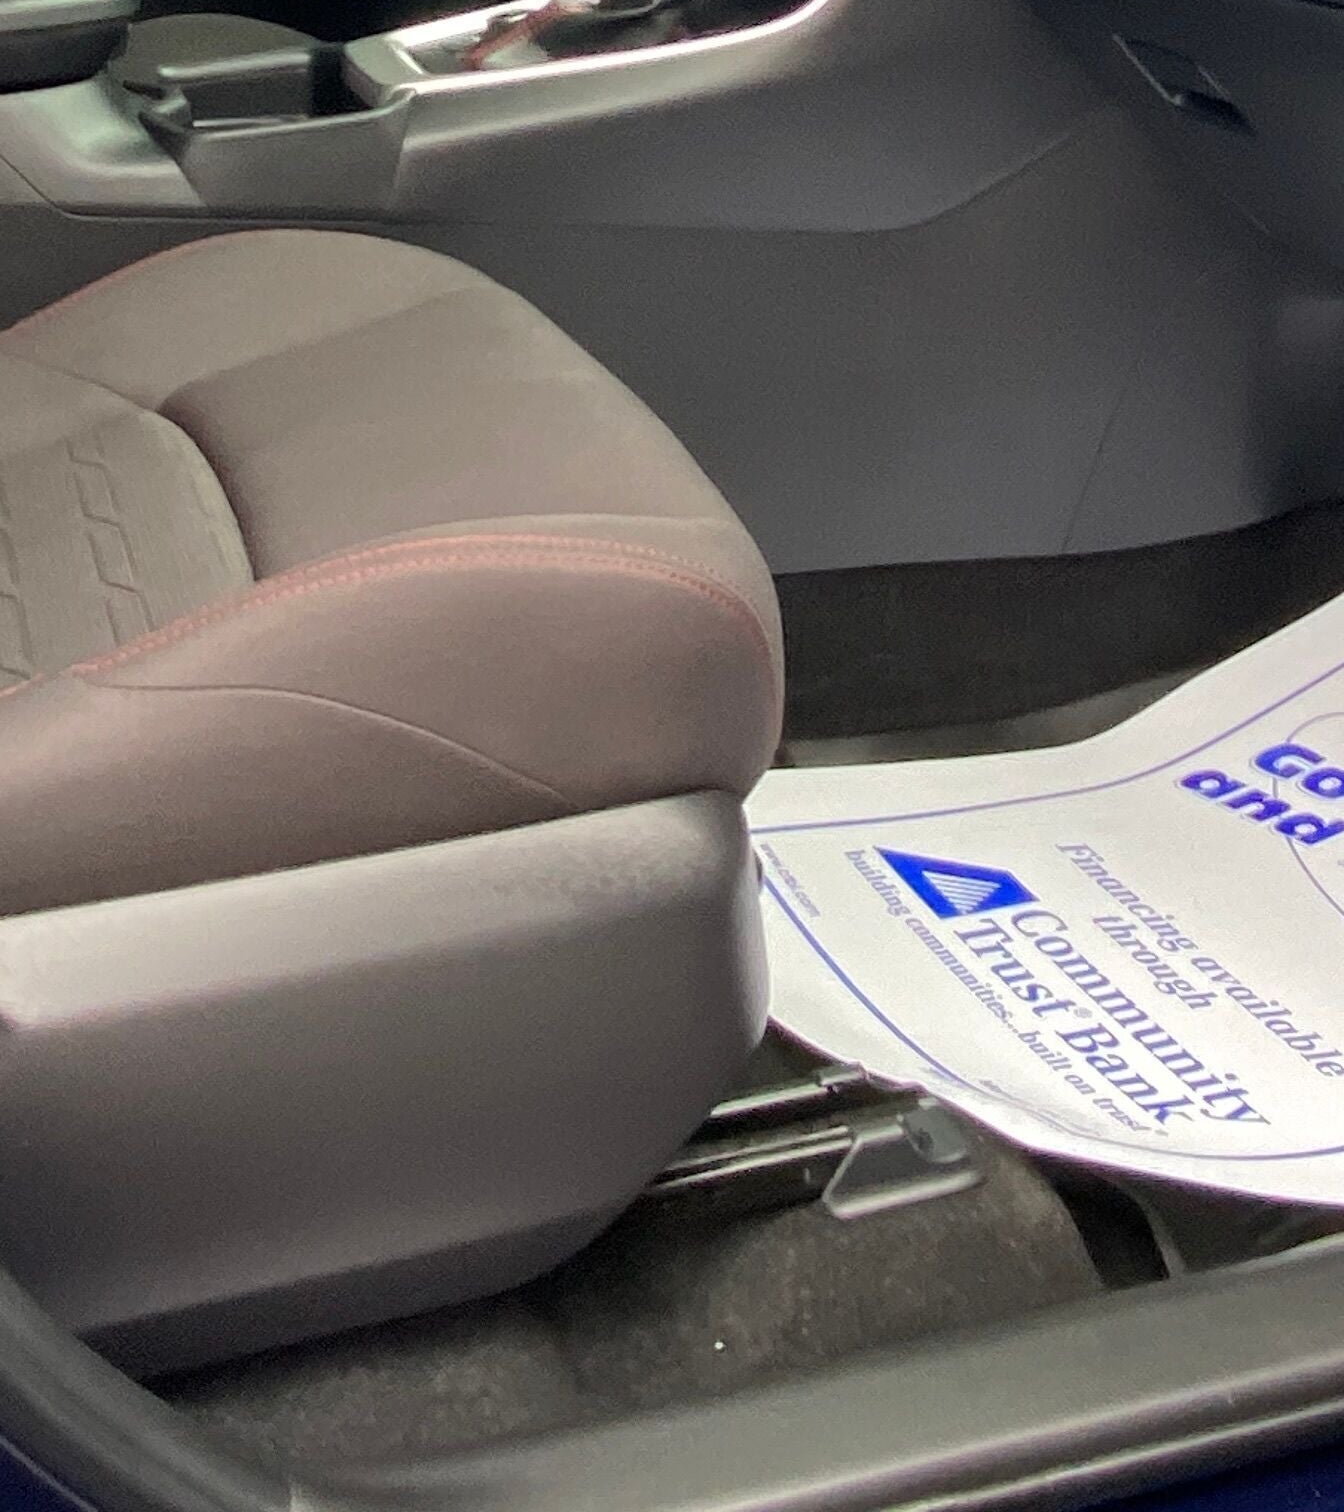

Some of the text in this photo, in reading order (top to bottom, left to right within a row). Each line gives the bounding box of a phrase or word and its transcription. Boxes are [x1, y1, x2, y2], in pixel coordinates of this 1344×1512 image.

[1055, 842, 1199, 953] Financing
[844, 848, 911, 918] building
[1063, 1073, 1096, 1096] on
[1010, 908, 1272, 1126] Community
[1092, 914, 1219, 1010] through
[1055, 1022, 1195, 1125] Bank
